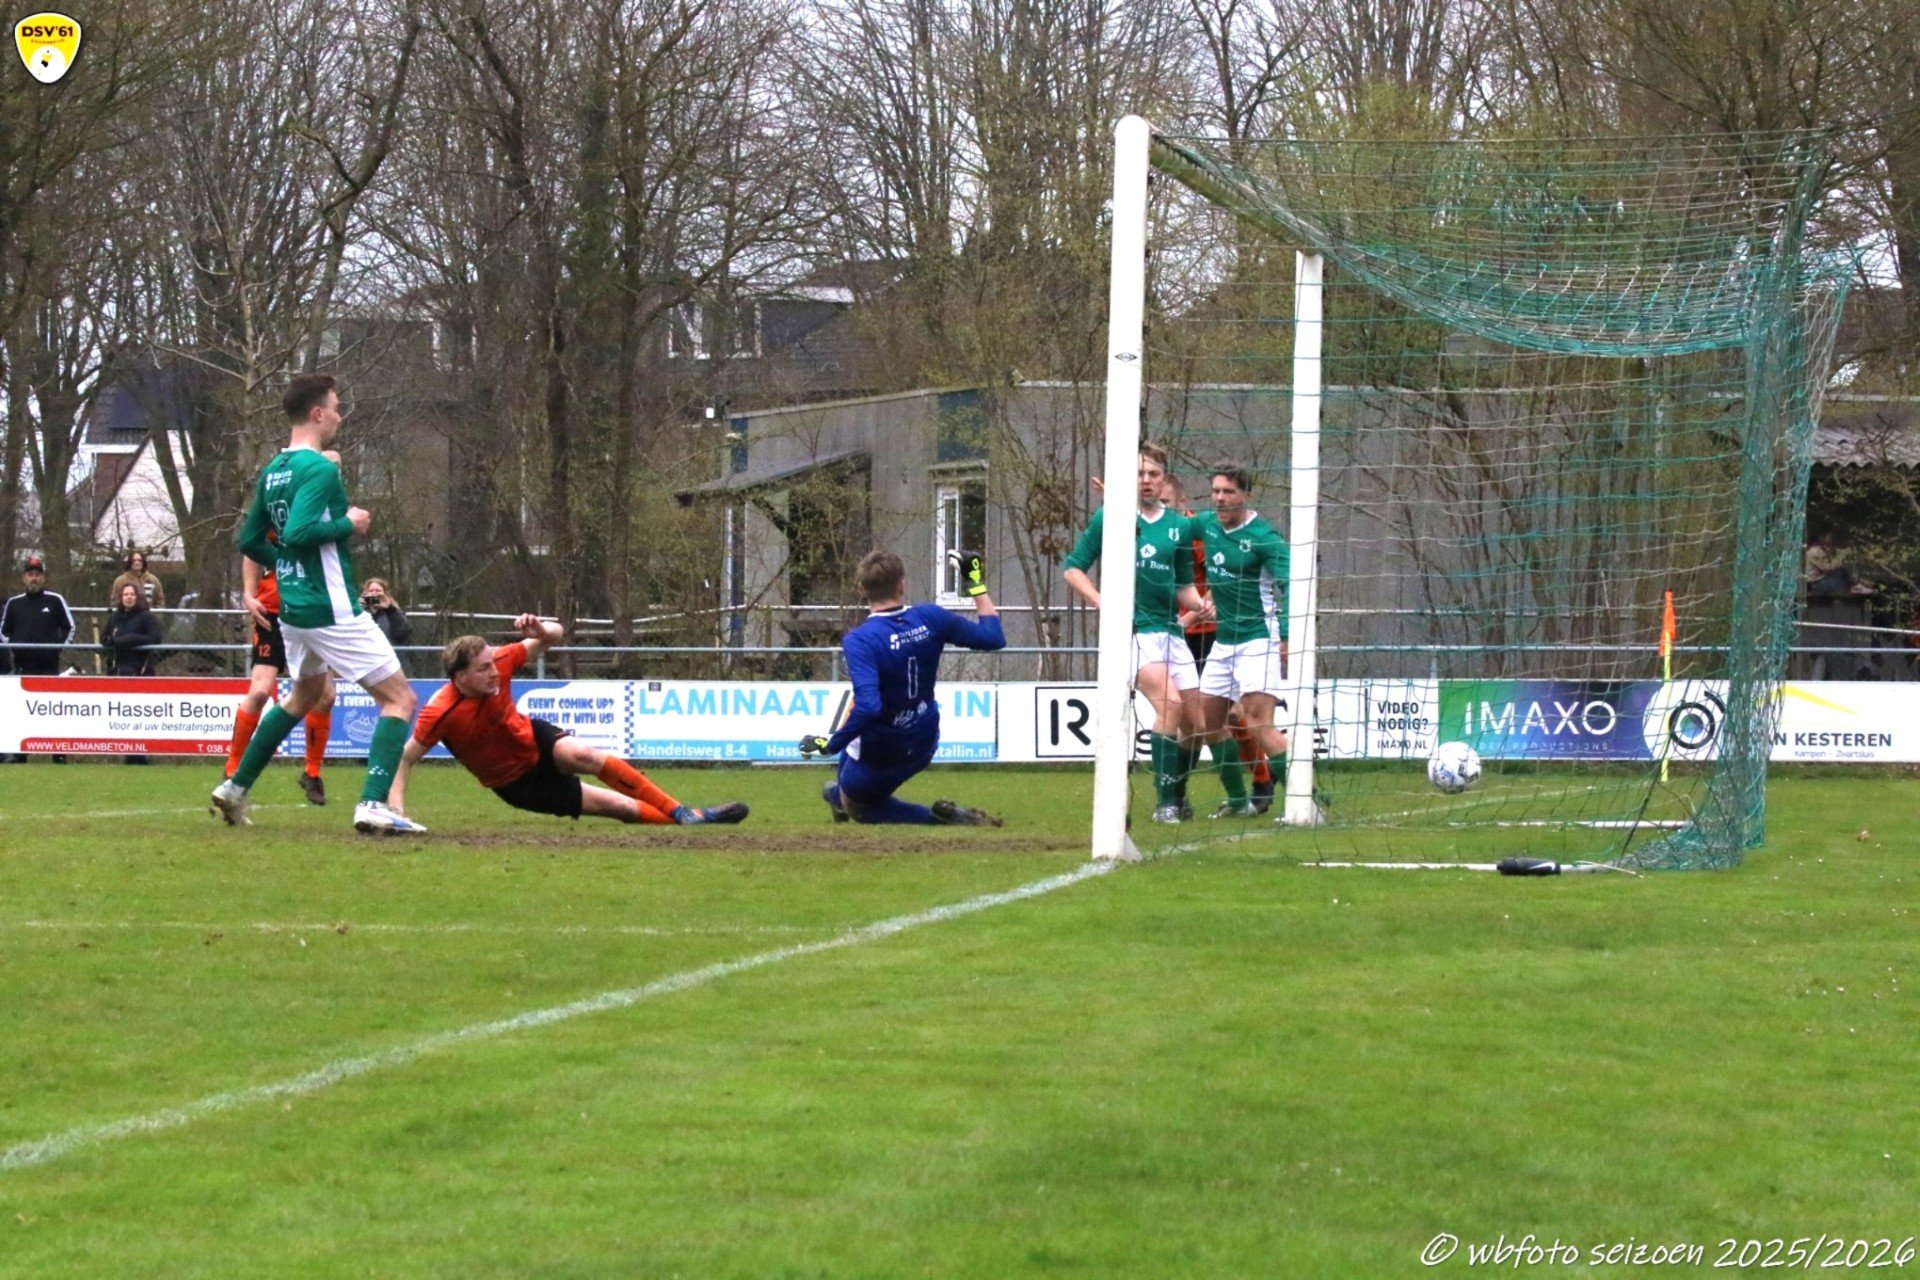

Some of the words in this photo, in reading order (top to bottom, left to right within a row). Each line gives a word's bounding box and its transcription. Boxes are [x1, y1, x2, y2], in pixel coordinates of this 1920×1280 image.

[258, 644, 271, 657] 12
[343, 695, 376, 707] EVENTS
[528, 697, 555, 709] EVENT
[559, 697, 593, 709] COMING
[596, 697, 614, 709] UP?
[639, 688, 829, 716] LAMINAAT
[26, 700, 101, 716] Veldman
[108, 701, 174, 718] Hasselt
[180, 702, 231, 718] Beton
[1377, 702, 1419, 714] VIDEO
[562, 712, 571, 723] IT
[574, 712, 596, 724] WITH
[599, 712, 614, 724] US!
[1377, 718, 1429, 730] NODIG?
[1465, 701, 1616, 735] IMAXO
[109, 721, 131, 731] Voor
[133, 721, 142, 731] al
[145, 723, 158, 731] uw
[1377, 740, 1428, 749] IMAXO.NL
[1795, 732, 1892, 747] KESTEREN
[27, 742, 148, 752] WWW.VELDMANBETON.NL
[207, 744, 223, 753] 038
[637, 743, 722, 758] Handelsweg
[725, 744, 748, 757] 8-4
[766, 744, 801, 757] Hass
[935, 744, 992, 758] tallin.nl
[1795, 750, 1826, 758] Kampen
[1836, 750, 1875, 758] Zwartsluis
